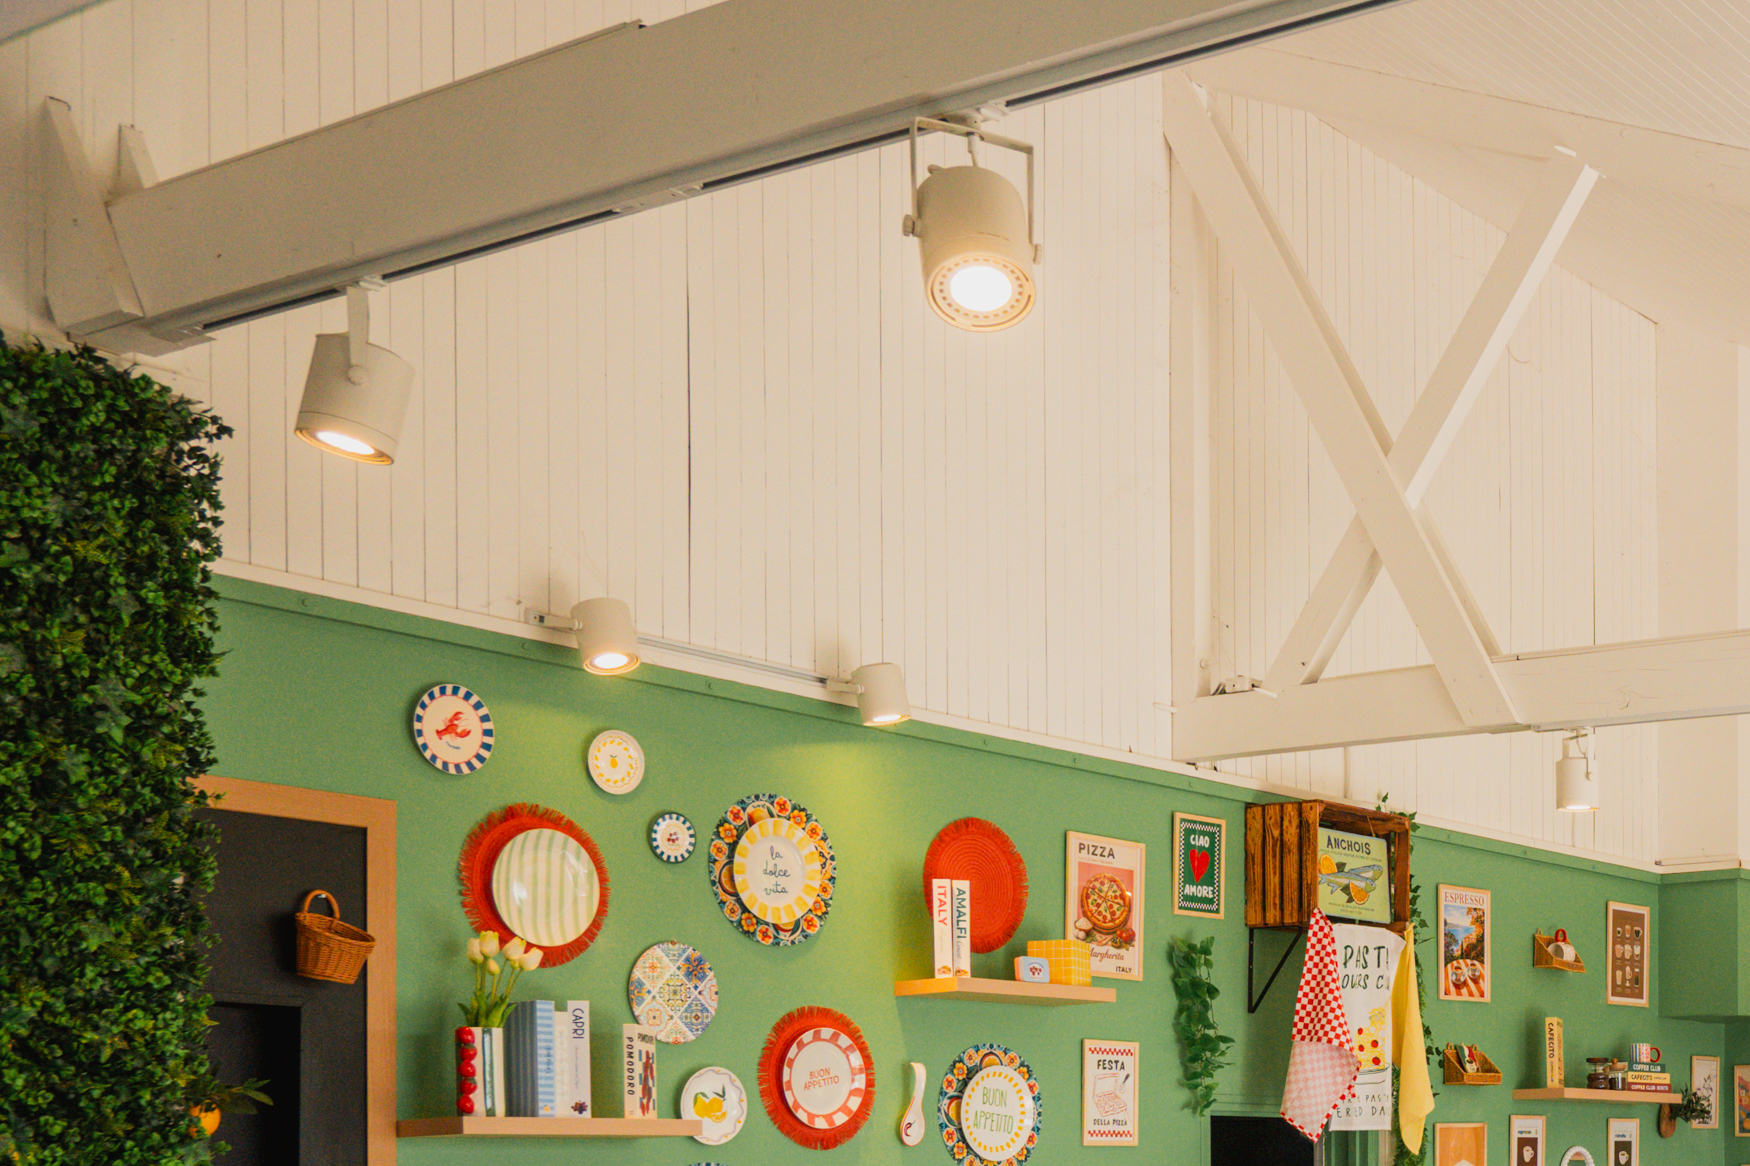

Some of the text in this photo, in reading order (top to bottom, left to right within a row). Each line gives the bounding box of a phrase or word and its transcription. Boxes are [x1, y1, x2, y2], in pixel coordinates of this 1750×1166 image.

[1190, 834, 1210, 848] CIAO
[1327, 835, 1372, 855] ANCHOIS
[769, 845, 783, 860] la
[1078, 842, 1116, 859] PIZZA
[763, 860, 791, 878] dolce
[764, 881, 788, 895] vita
[1184, 884, 1214, 898] AMORE
[937, 885, 948, 926] ITALY
[1444, 891, 1485, 906] ESPRESSO
[956, 887, 967, 939] AMALFI
[1115, 966, 1133, 974] ITALY
[572, 1008, 586, 1039] CAPRI
[626, 1036, 635, 1096] POMODORO
[1097, 1059, 1125, 1071] FESTA
[809, 1067, 831, 1081] BUON
[803, 1075, 840, 1091] APPETITO
[982, 1086, 1007, 1108] BUON
[973, 1110, 1014, 1134] APPETITO
[1093, 1118, 1128, 1126] DELLA PIZZA
